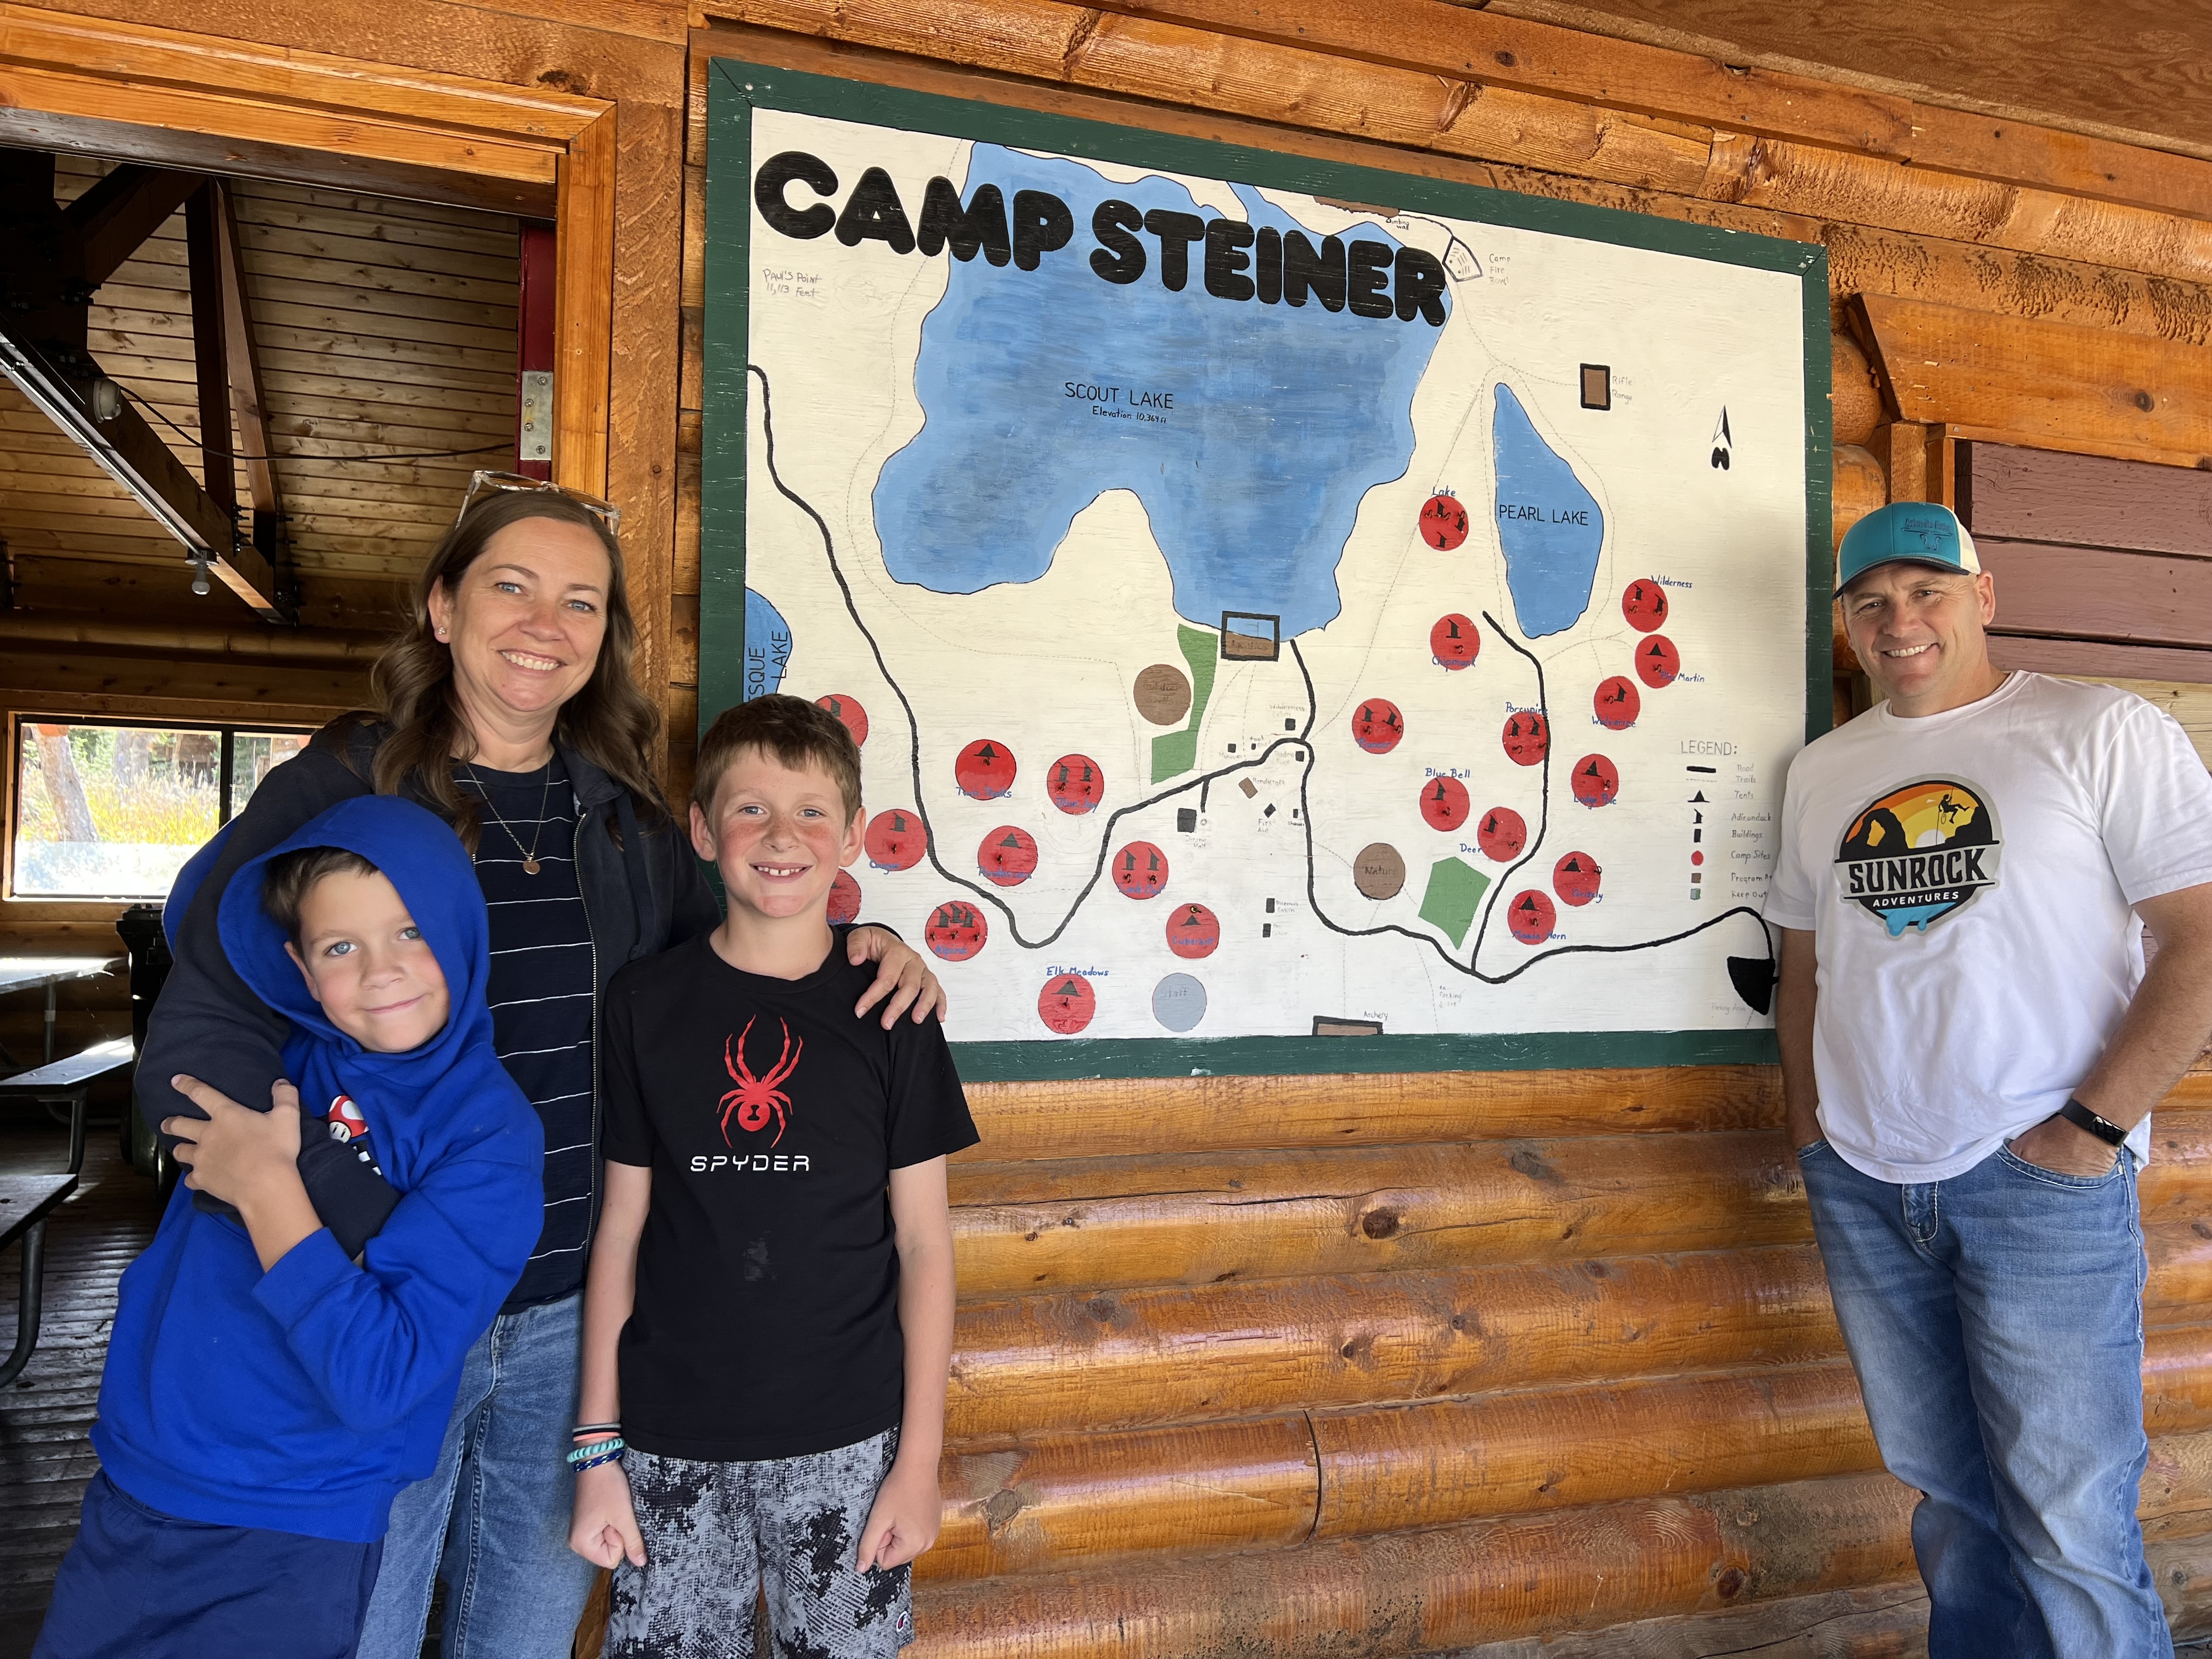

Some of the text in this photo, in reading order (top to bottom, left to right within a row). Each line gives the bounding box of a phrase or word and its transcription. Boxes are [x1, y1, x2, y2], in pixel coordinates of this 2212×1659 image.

[754, 150, 1446, 327] CAMP STEINER
[1489, 253, 1510, 263] Camp
[1490, 266, 1505, 274] Fire
[766, 282, 820, 298] 11,113 Feet
[1612, 375, 1633, 386] Rifle
[1064, 382, 1173, 409] SCOUT LAKE
[1612, 389, 1633, 405] Range
[1092, 405, 1132, 419] Elevation
[1136, 411, 1159, 422] 10,364
[1431, 485, 1456, 496] Lake
[1499, 504, 1589, 526] PEARL LAKE
[1651, 574, 1693, 589] Wilderness
[770, 630, 788, 679] LAKE
[1432, 655, 1476, 672] Chipmunk
[748, 647, 765, 701] SQUE
[1661, 670, 1705, 683] Pine Martin
[1505, 702, 1549, 720] Porcupine
[1681, 740, 1737, 756] LEGEND:
[1425, 768, 1470, 778] Blue Bell
[1737, 763, 1754, 772] Road
[1735, 774, 1756, 783] Trails
[955, 786, 1012, 798] Twin Peaks
[1734, 790, 1754, 800] Tents
[1573, 793, 1617, 810] Lodge Pole
[1731, 812, 1772, 821] Adirondack
[1732, 829, 1763, 843] Buildings
[1460, 844, 1482, 853] Deer
[1731, 850, 1771, 865] Camp Sites
[869, 858, 901, 875] Cougar
[1848, 848, 1989, 894] SUNROCK
[1731, 872, 1763, 884] Program
[1572, 888, 1604, 903] Grizzly
[1731, 890, 1750, 899] Keep
[1872, 891, 1960, 907] ADVENTURES
[1547, 930, 1567, 940] Horn
[935, 944, 967, 960] Alpine
[1046, 966, 1109, 976] Elk Meadows
[1363, 1011, 1389, 1020] Archery
[690, 1155, 810, 1172] SPYDER
